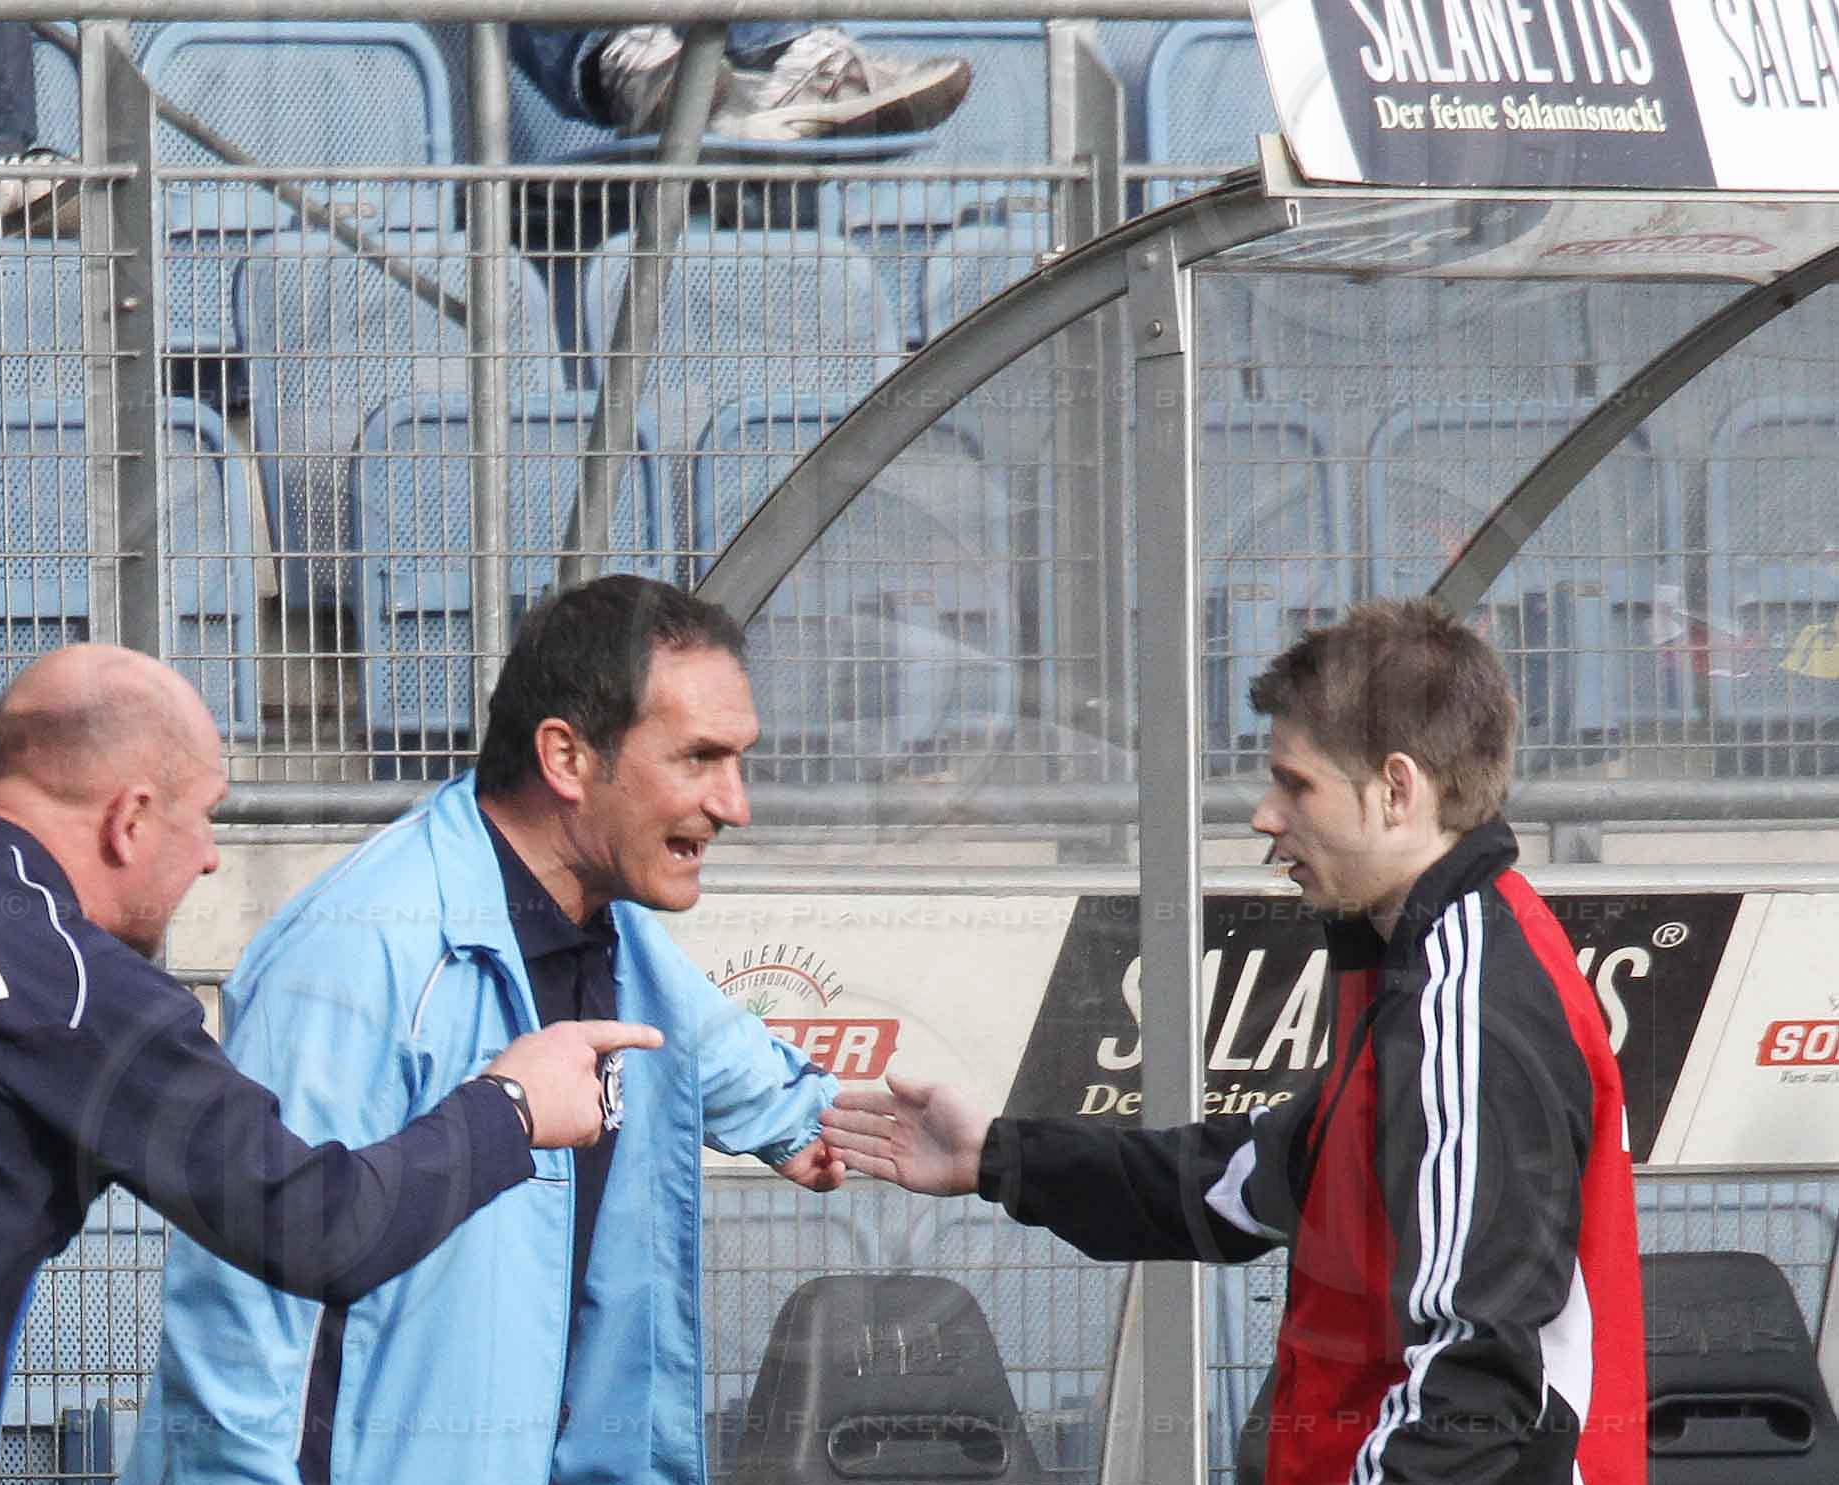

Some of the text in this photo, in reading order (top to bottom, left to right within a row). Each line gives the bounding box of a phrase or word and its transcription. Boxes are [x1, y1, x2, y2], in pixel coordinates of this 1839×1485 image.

[1374, 96, 1666, 133] Der feine Salamisnack!
[1076, 1084, 1142, 1116] De
